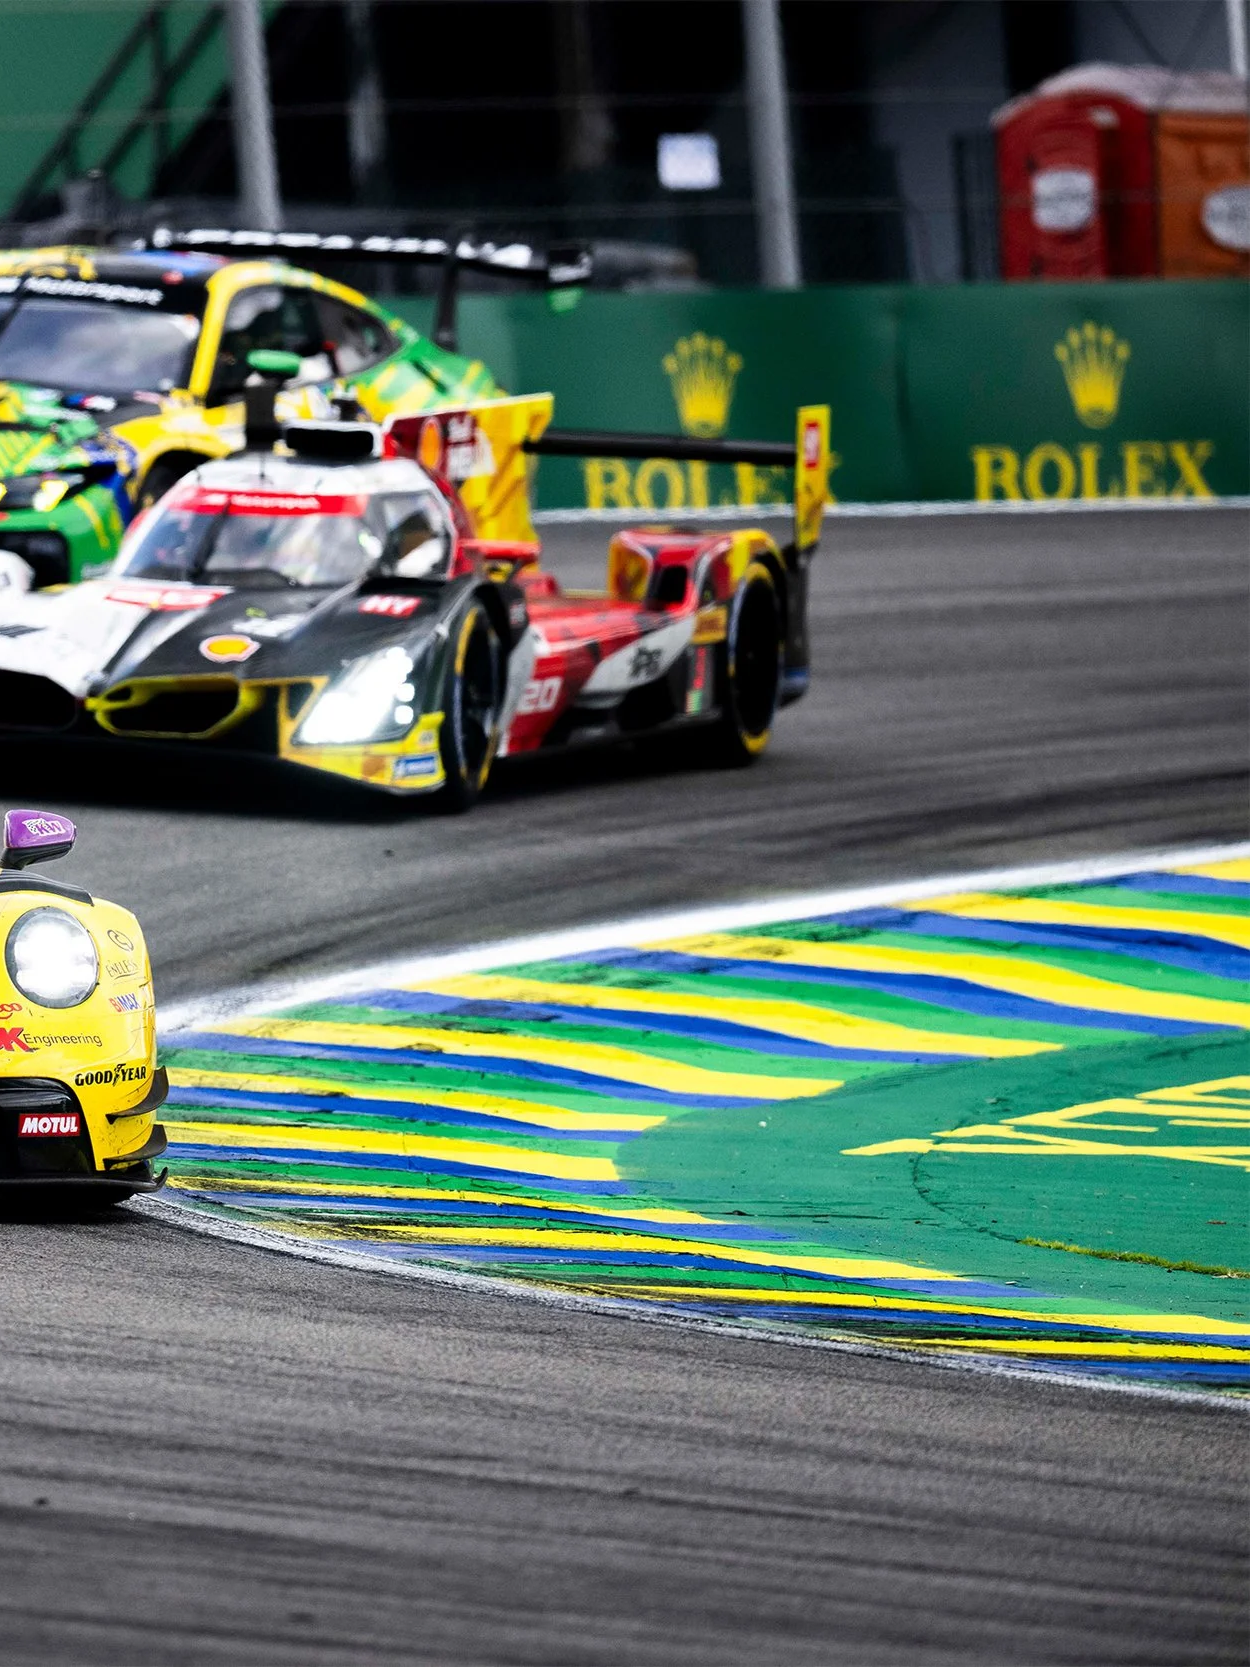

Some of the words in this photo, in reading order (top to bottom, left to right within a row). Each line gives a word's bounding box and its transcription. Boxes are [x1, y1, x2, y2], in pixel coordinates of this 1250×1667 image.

[582, 457, 841, 509] ROLE
[971, 440, 1214, 503] ROLEX
[516, 677, 562, 714] 20
[35, 821, 65, 836] KW
[23, 1033, 103, 1047] Engineering
[21, 1116, 78, 1133] MOTUL
